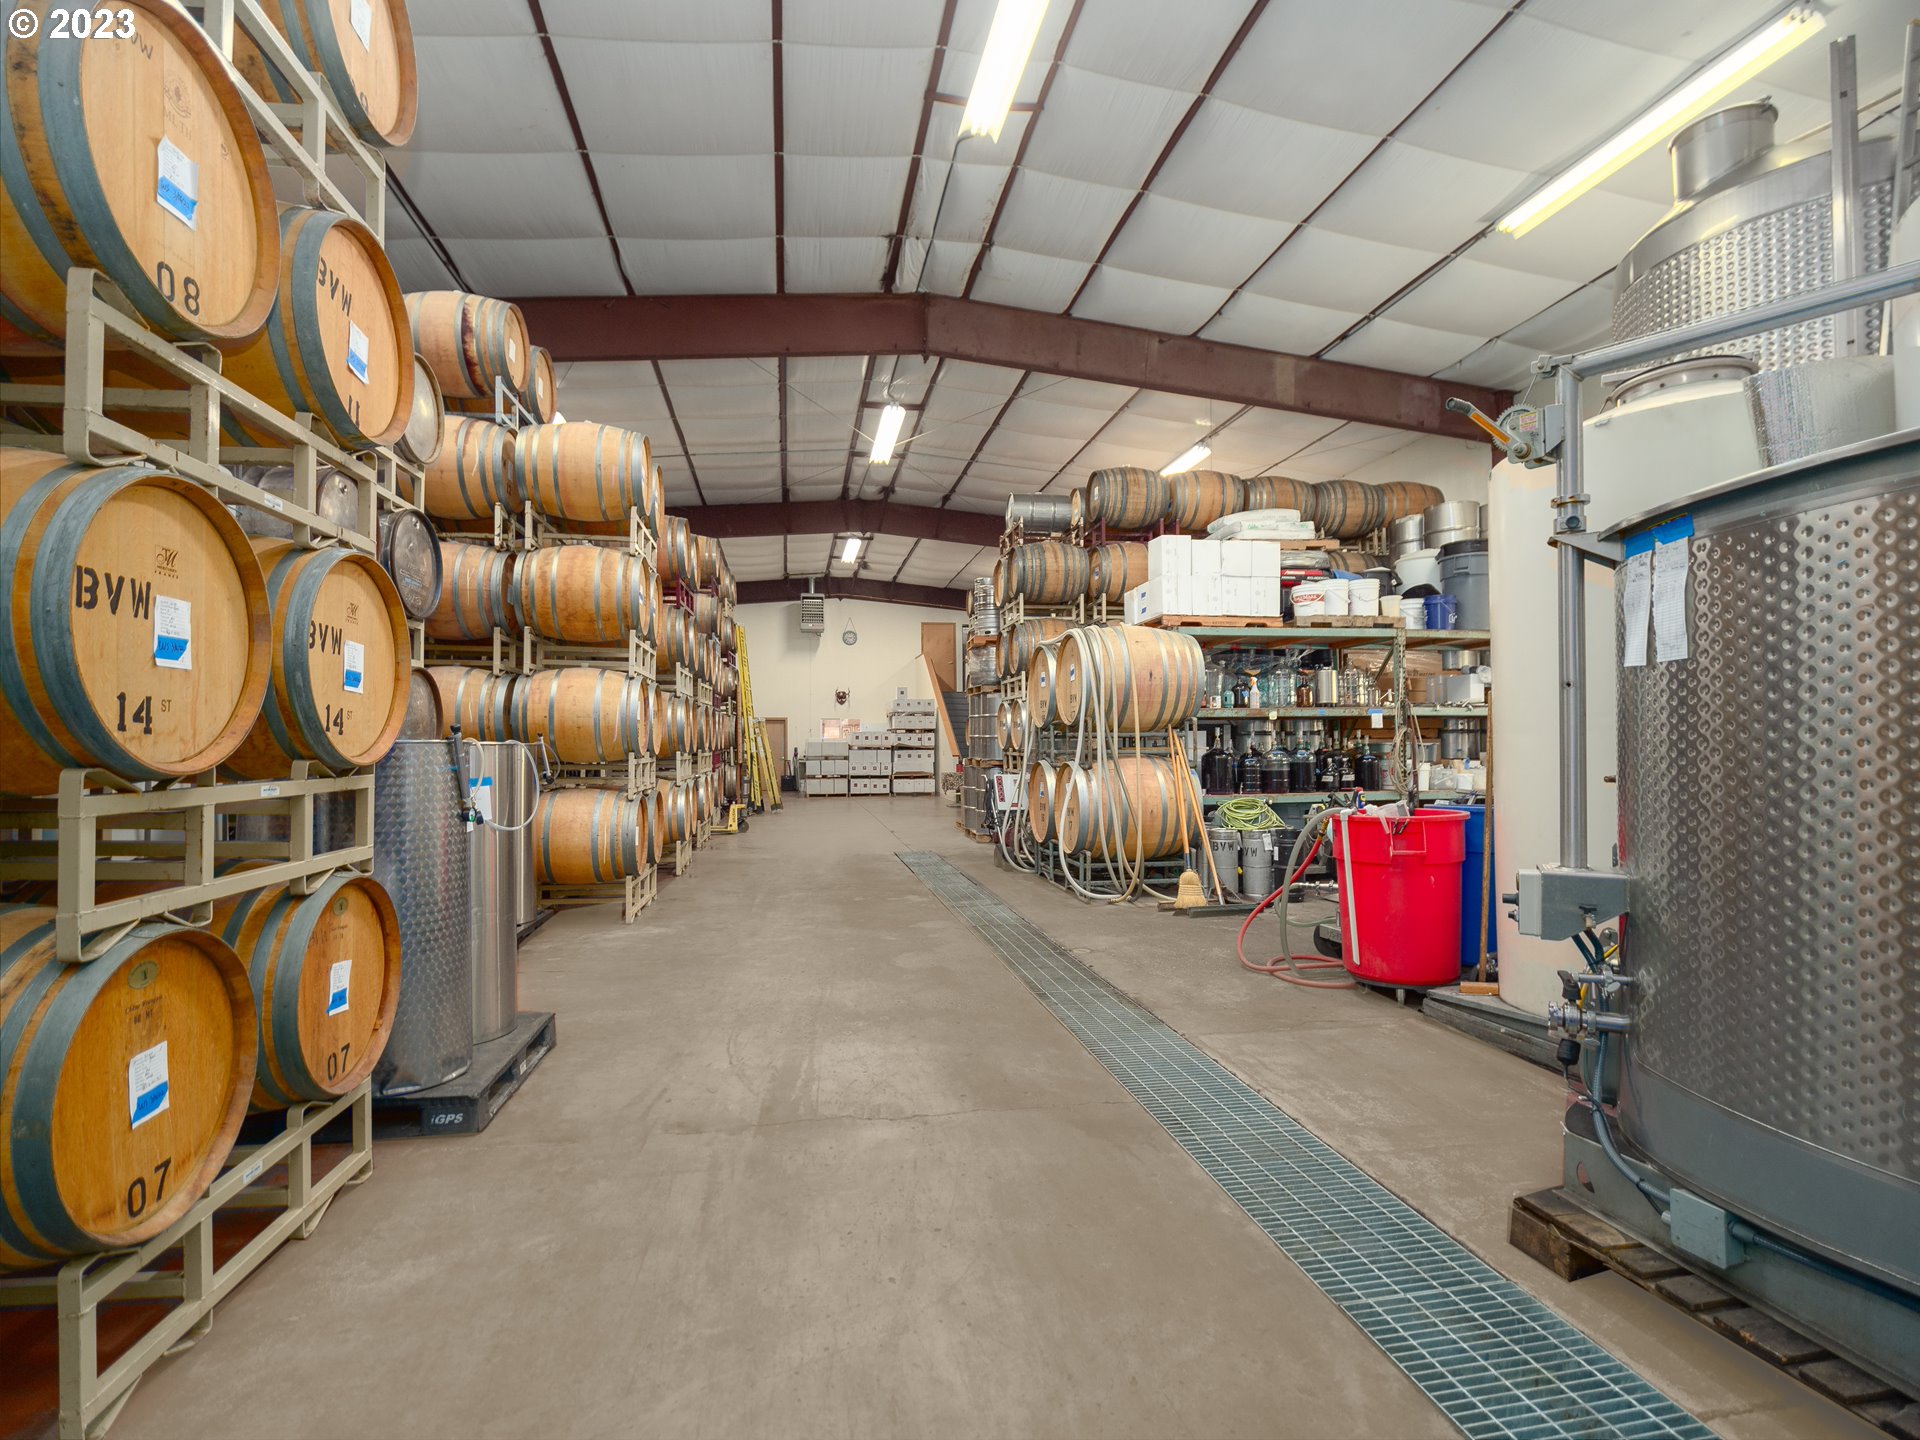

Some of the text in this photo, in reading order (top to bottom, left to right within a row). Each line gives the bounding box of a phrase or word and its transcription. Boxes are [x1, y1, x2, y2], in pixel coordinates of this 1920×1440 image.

[156, 261, 200, 316] 08
[75, 565, 151, 620] BVW
[309, 619, 342, 656] BVW
[117, 691, 173, 735] 14 ST
[325, 703, 353, 736] 14 ST
[1213, 842, 1234, 851] BVW
[1242, 847, 1258, 857] VW
[327, 1043, 351, 1081] 07
[431, 1113, 463, 1124] iGPS
[127, 1156, 172, 1218] 07
